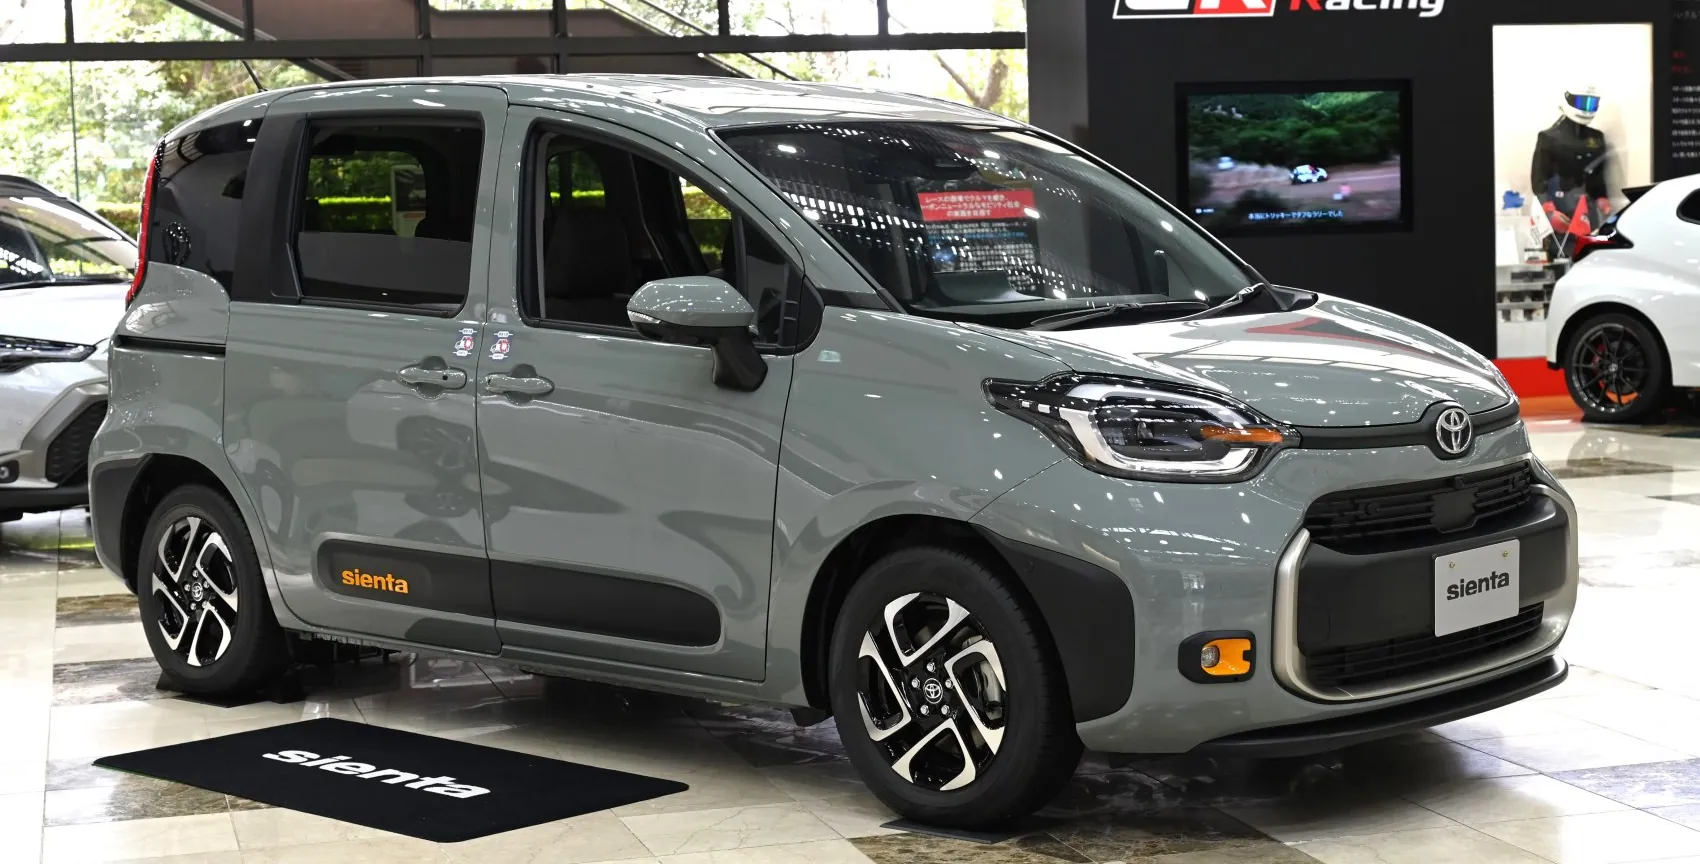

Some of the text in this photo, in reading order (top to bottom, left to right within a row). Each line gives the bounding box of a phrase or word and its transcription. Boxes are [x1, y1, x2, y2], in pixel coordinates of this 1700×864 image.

[341, 568, 409, 594] sienta
[1446, 571, 1509, 600] sienta
[262, 750, 491, 798] sienta
